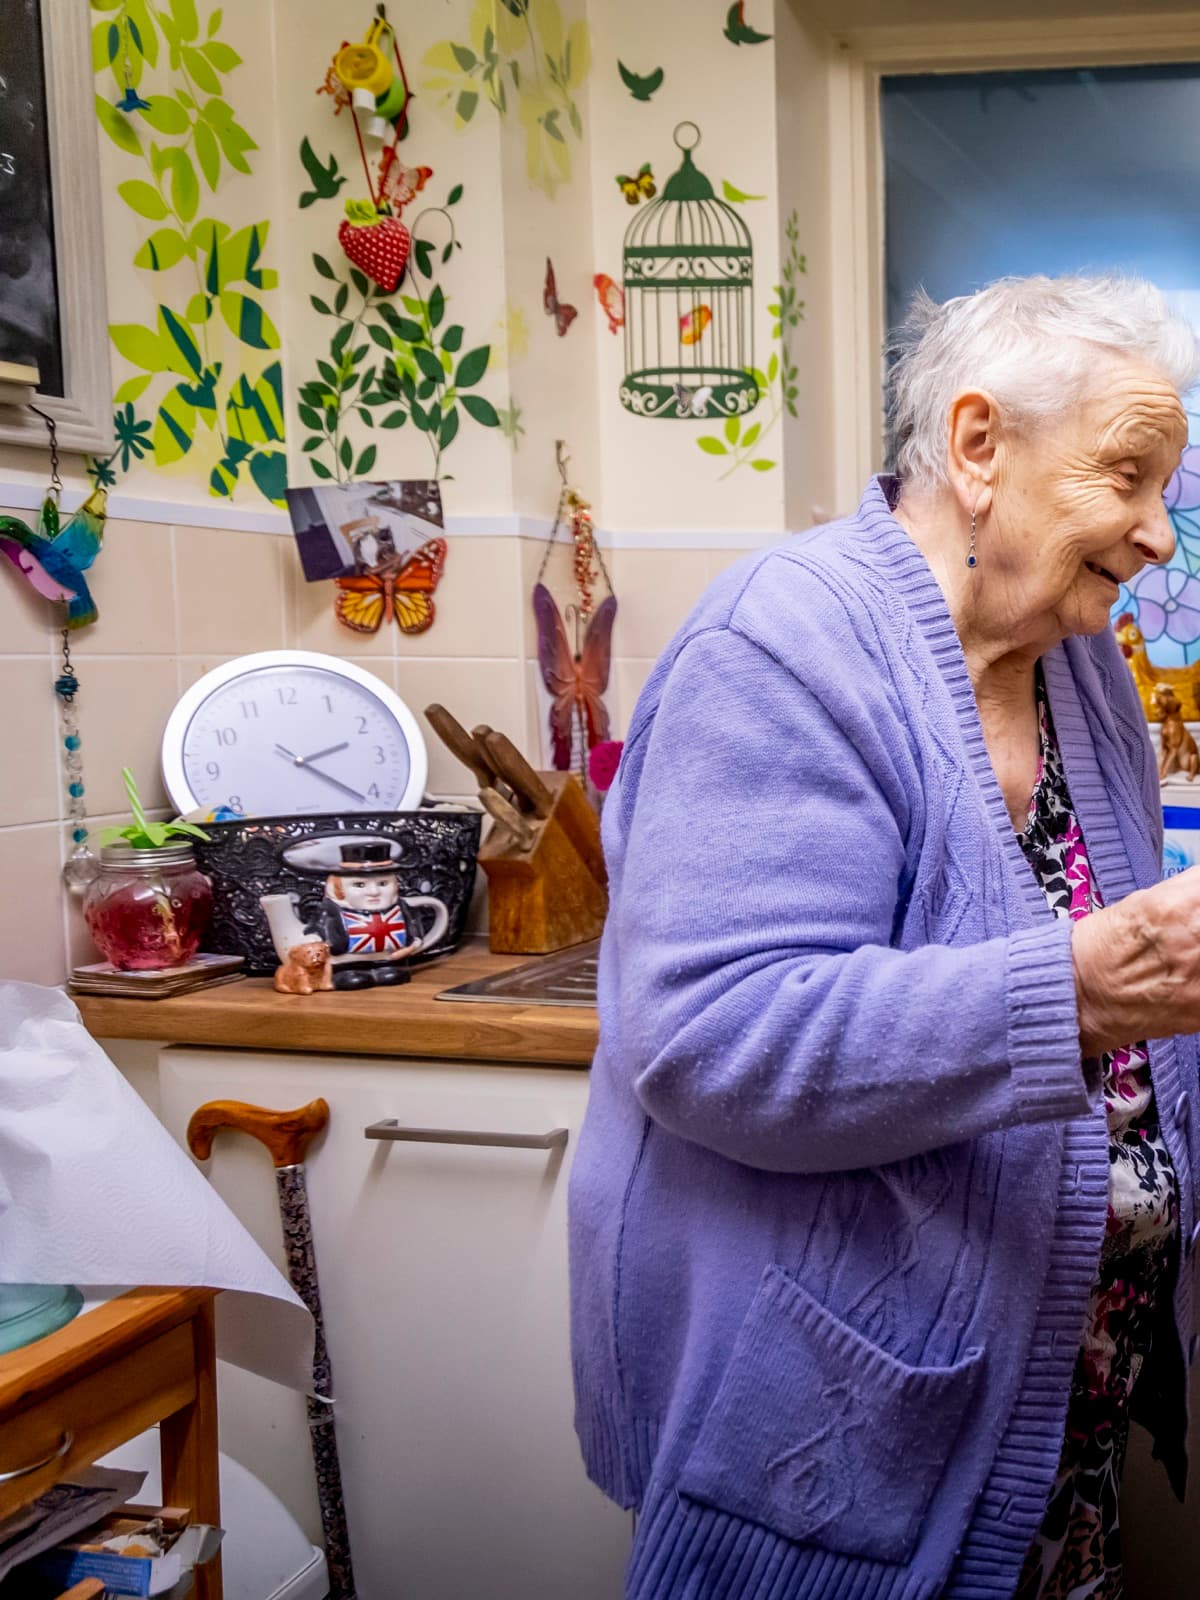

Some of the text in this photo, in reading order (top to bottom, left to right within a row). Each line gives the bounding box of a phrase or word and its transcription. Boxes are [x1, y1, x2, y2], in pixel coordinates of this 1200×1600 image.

[275, 687, 298, 705] 12
[323, 695, 333, 713] 1
[240, 700, 259, 719] 11
[355, 715, 369, 734] 2
[213, 727, 237, 747] 10
[374, 746, 386, 764] 3
[206, 762, 220, 781] 9
[367, 782, 381, 799] 4
[228, 796, 243, 814] 8
